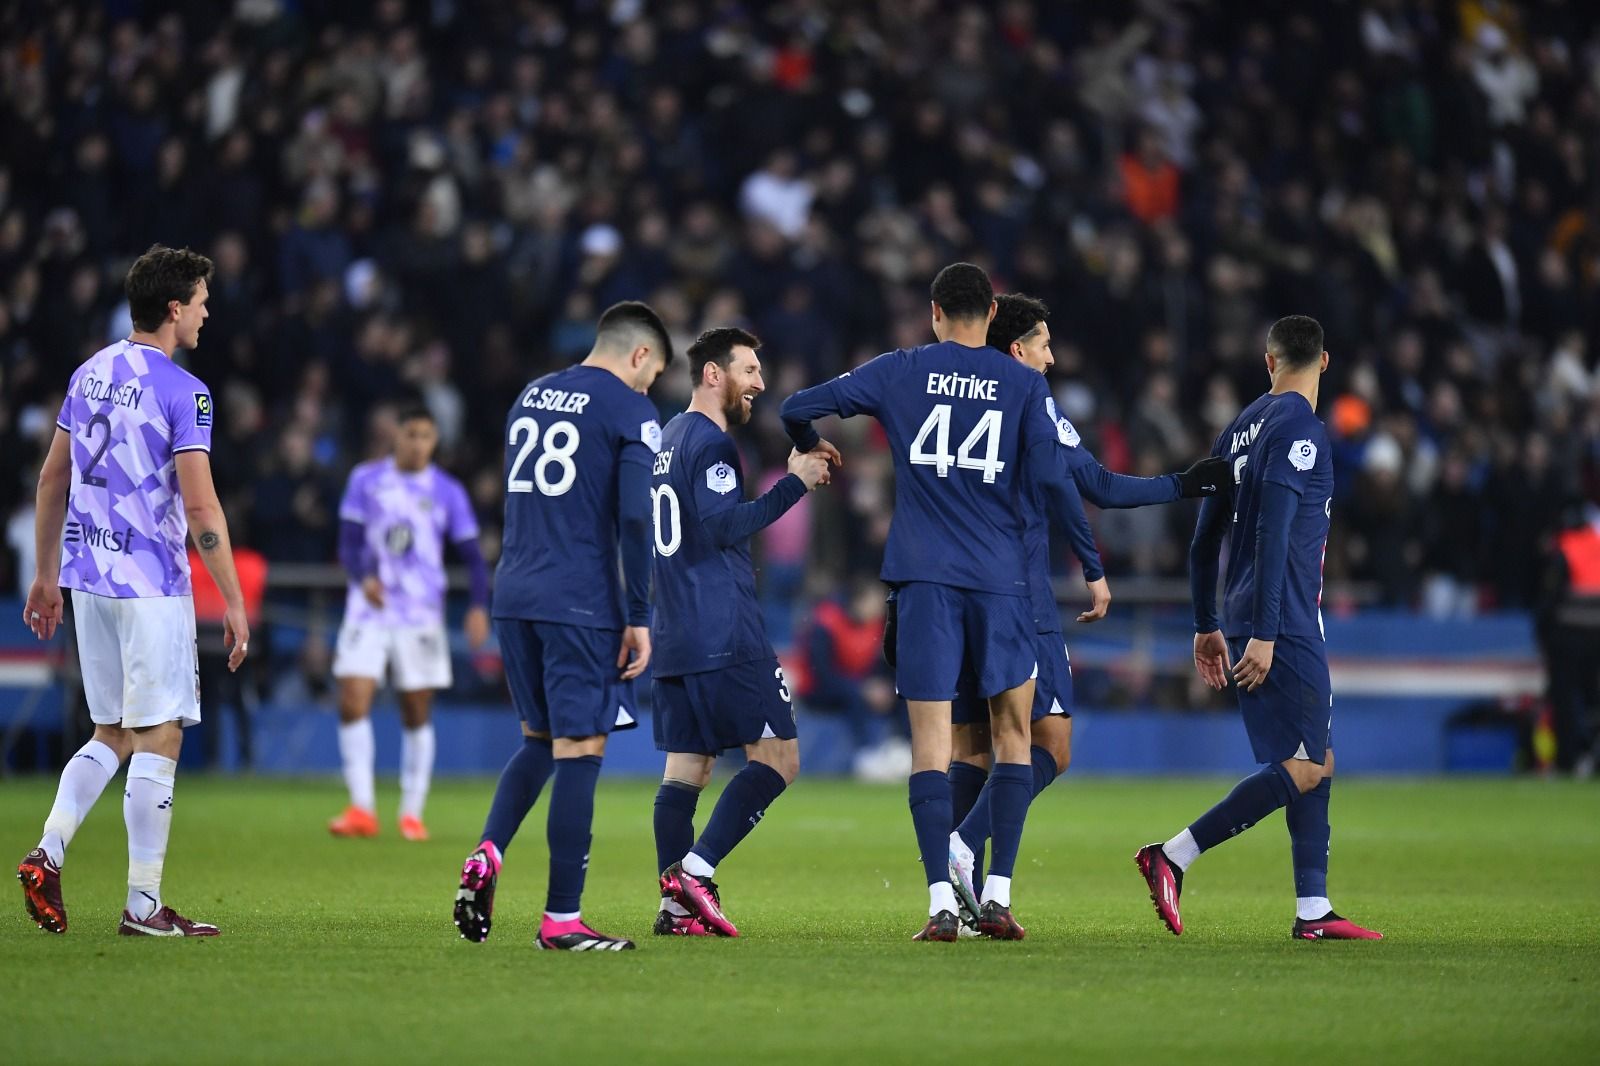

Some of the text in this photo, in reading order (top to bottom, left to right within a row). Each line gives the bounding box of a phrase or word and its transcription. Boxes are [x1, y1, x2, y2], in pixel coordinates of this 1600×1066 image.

[522, 387, 590, 414] C.SOLER
[81, 413, 111, 488] 2
[508, 417, 580, 496] 28
[910, 404, 1005, 484] 44
